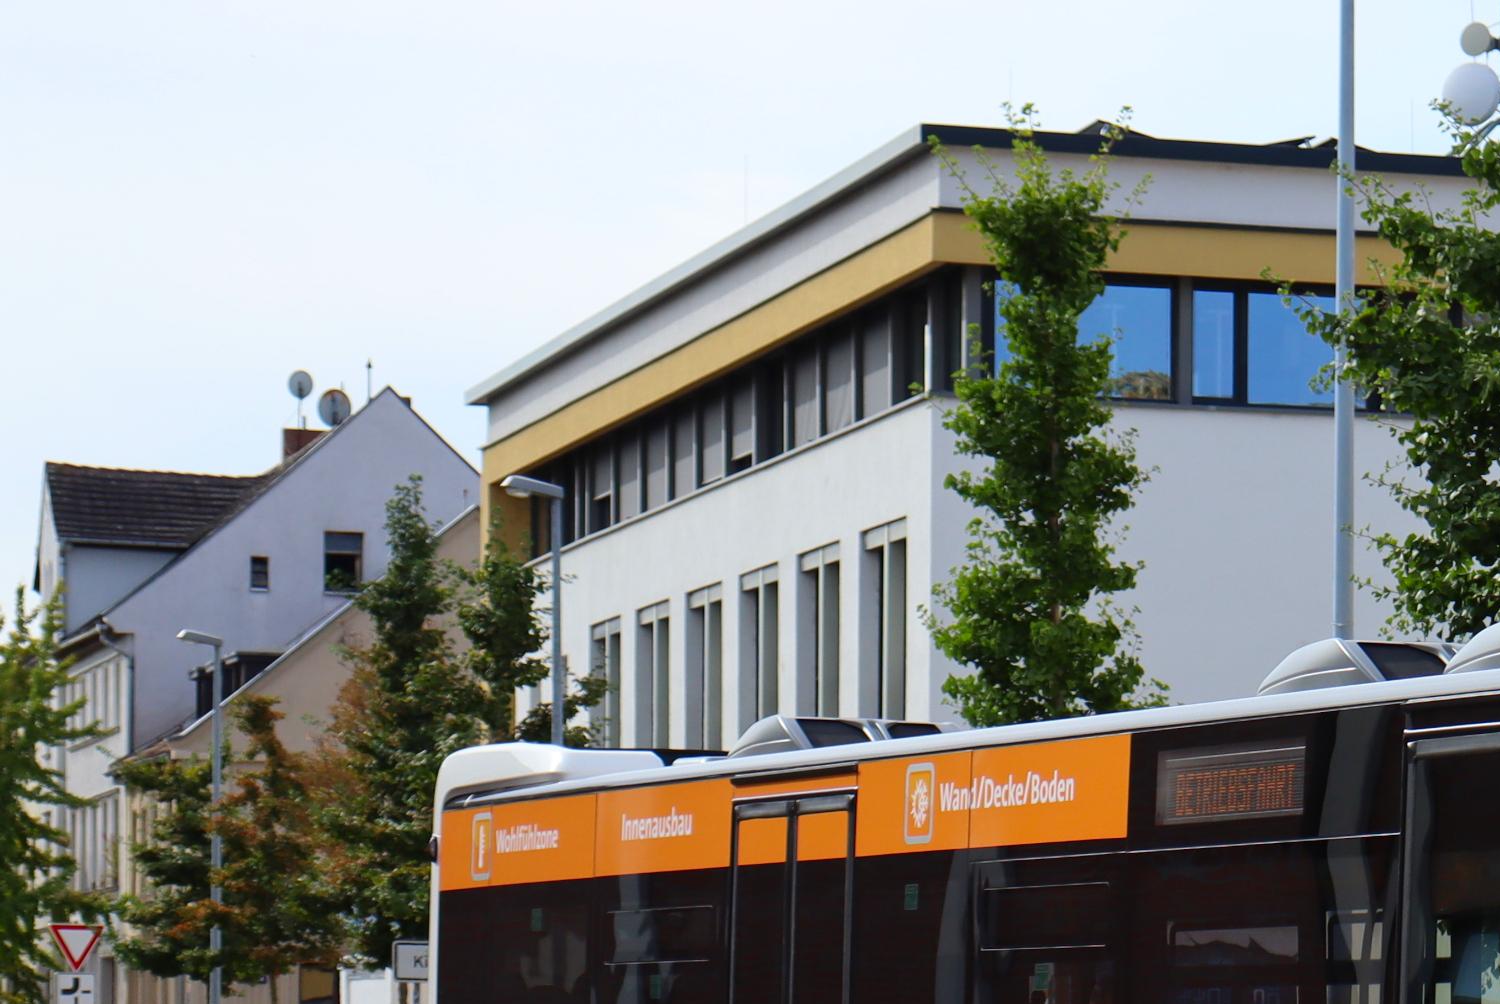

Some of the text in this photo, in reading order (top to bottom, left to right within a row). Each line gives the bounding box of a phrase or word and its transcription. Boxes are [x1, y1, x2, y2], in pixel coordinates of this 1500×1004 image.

[940, 770, 1074, 812] Wand/Decke/Boden
[496, 824, 560, 854] Wohlfühlzone
[621, 806, 693, 841] Innenausbau
